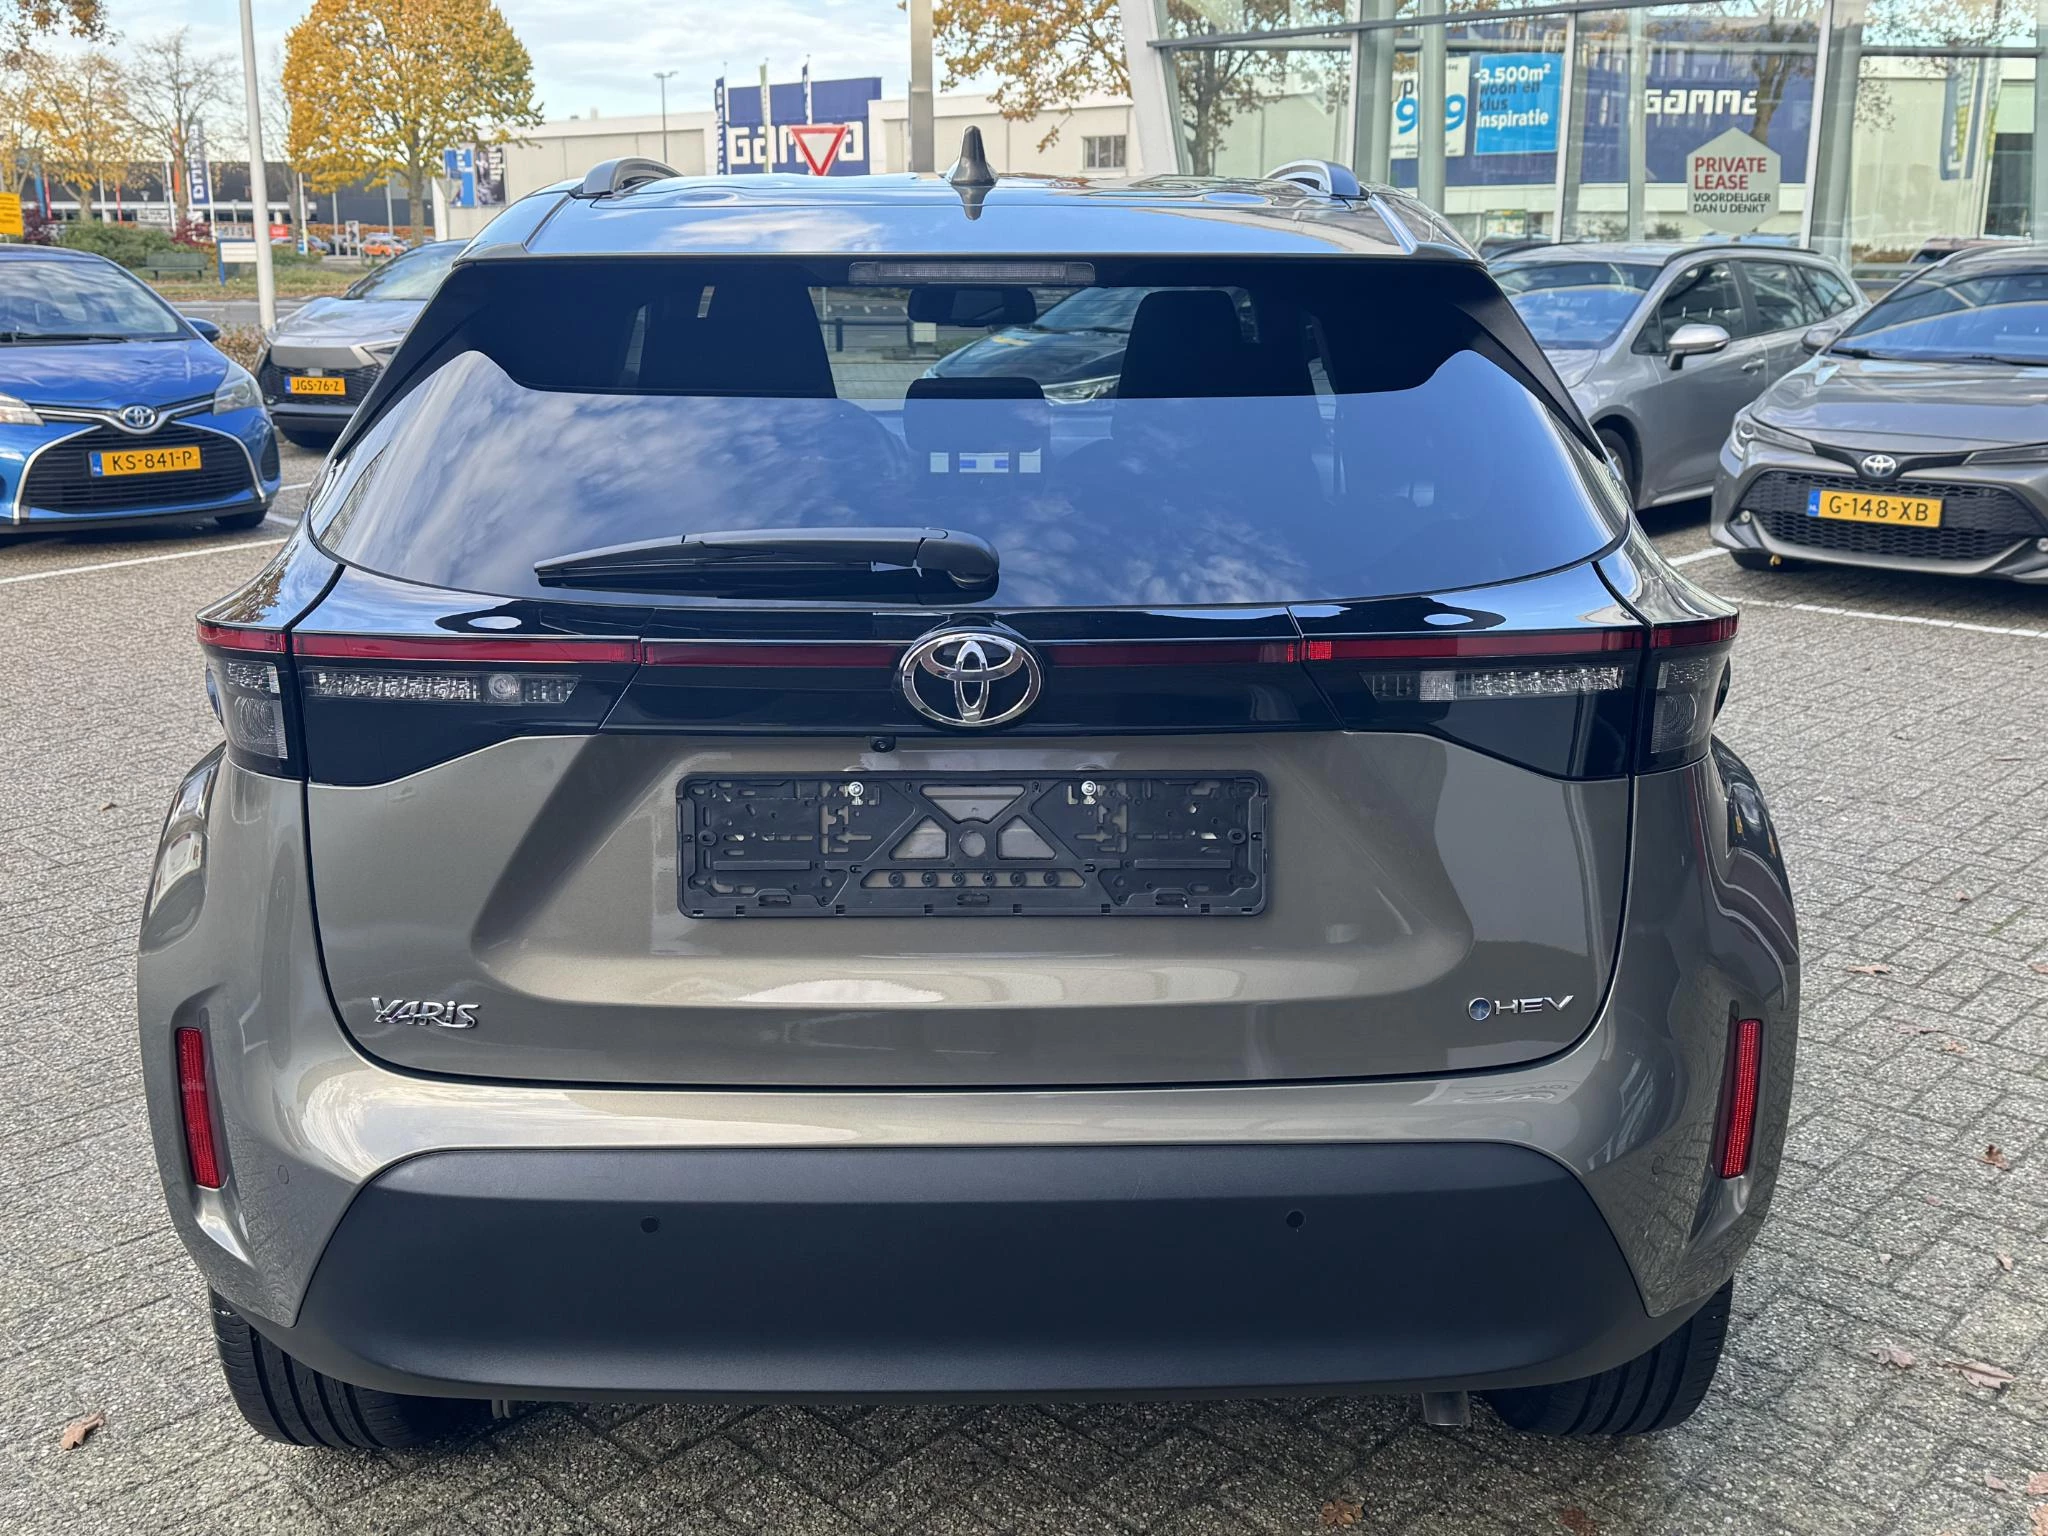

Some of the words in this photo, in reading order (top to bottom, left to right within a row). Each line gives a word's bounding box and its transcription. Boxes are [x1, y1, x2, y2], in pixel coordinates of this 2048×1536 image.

[1480, 83, 1517, 95] woon
[1478, 97, 1508, 110] klus
[1476, 108, 1549, 130] inspiratie
[1694, 157, 1767, 172] PRIVATE
[1694, 175, 1748, 190] LEASE
[1693, 193, 1770, 203] VOORDELIGER
[1693, 204, 1717, 213] DAN
[1720, 204, 1727, 213] U
[1730, 204, 1766, 213] DENKT
[111, 450, 192, 471] KS-841-P
[1829, 495, 1929, 521] G-148-XB
[1494, 995, 1574, 1015] HEV
